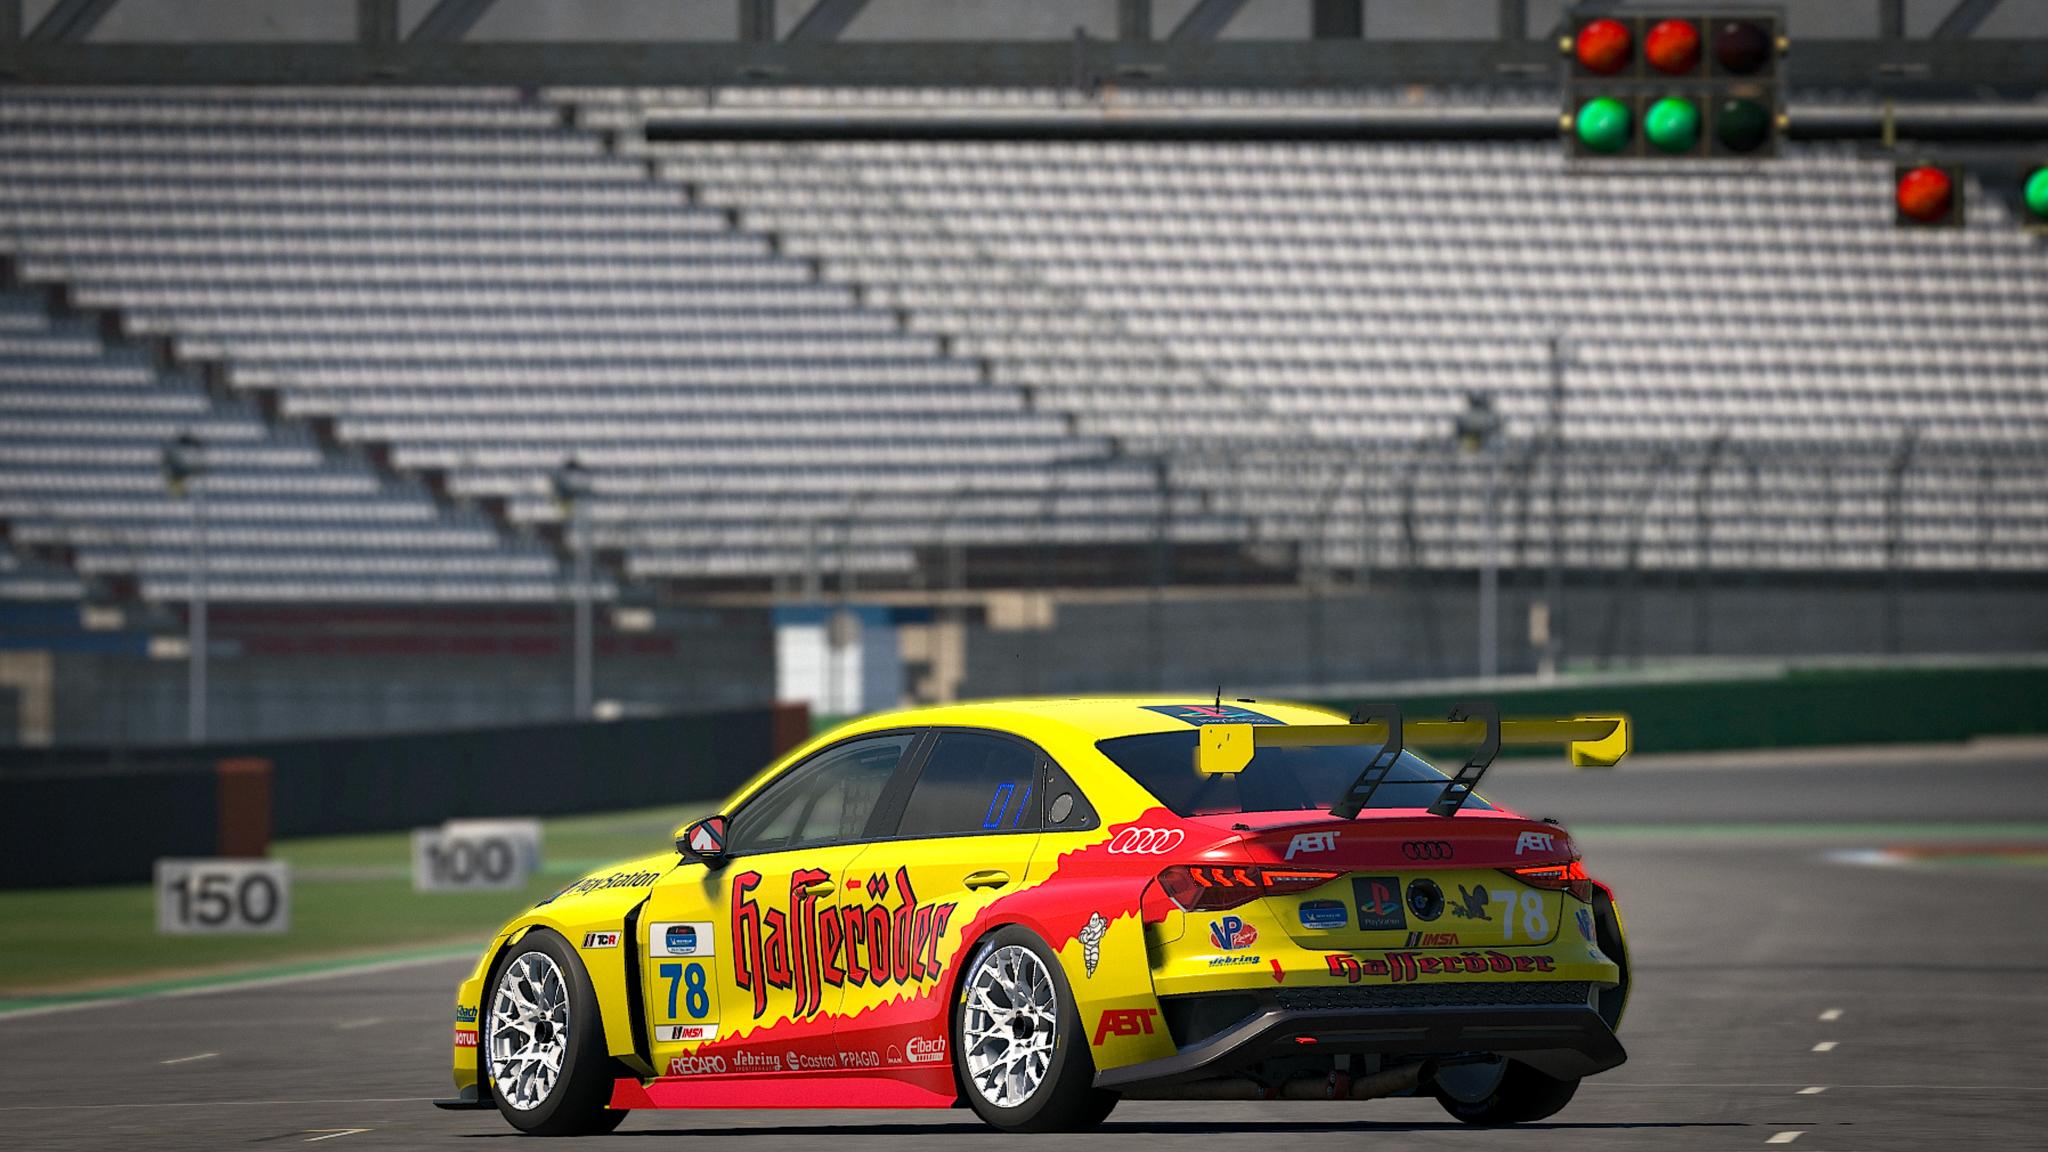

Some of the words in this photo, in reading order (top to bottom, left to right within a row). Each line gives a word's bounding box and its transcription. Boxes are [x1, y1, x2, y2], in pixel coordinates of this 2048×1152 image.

[1284, 831, 1336, 861] ABT
[1515, 831, 1554, 856] ABT
[424, 840, 515, 884] 100
[167, 872, 278, 926] 150
[1490, 889, 1550, 941] 78
[597, 934, 616, 945] TCR
[1209, 915, 1243, 951] VP
[1422, 933, 1459, 946] IMSA
[659, 962, 710, 1019] 78
[681, 1027, 703, 1039] IMSA
[1093, 1008, 1155, 1046] ABT
[732, 1050, 783, 1072] Sebring
[800, 1054, 837, 1068] Castrol
[849, 1051, 880, 1067] PAGID
[906, 1035, 946, 1063] Eibach
[670, 1055, 727, 1075] RECARO
